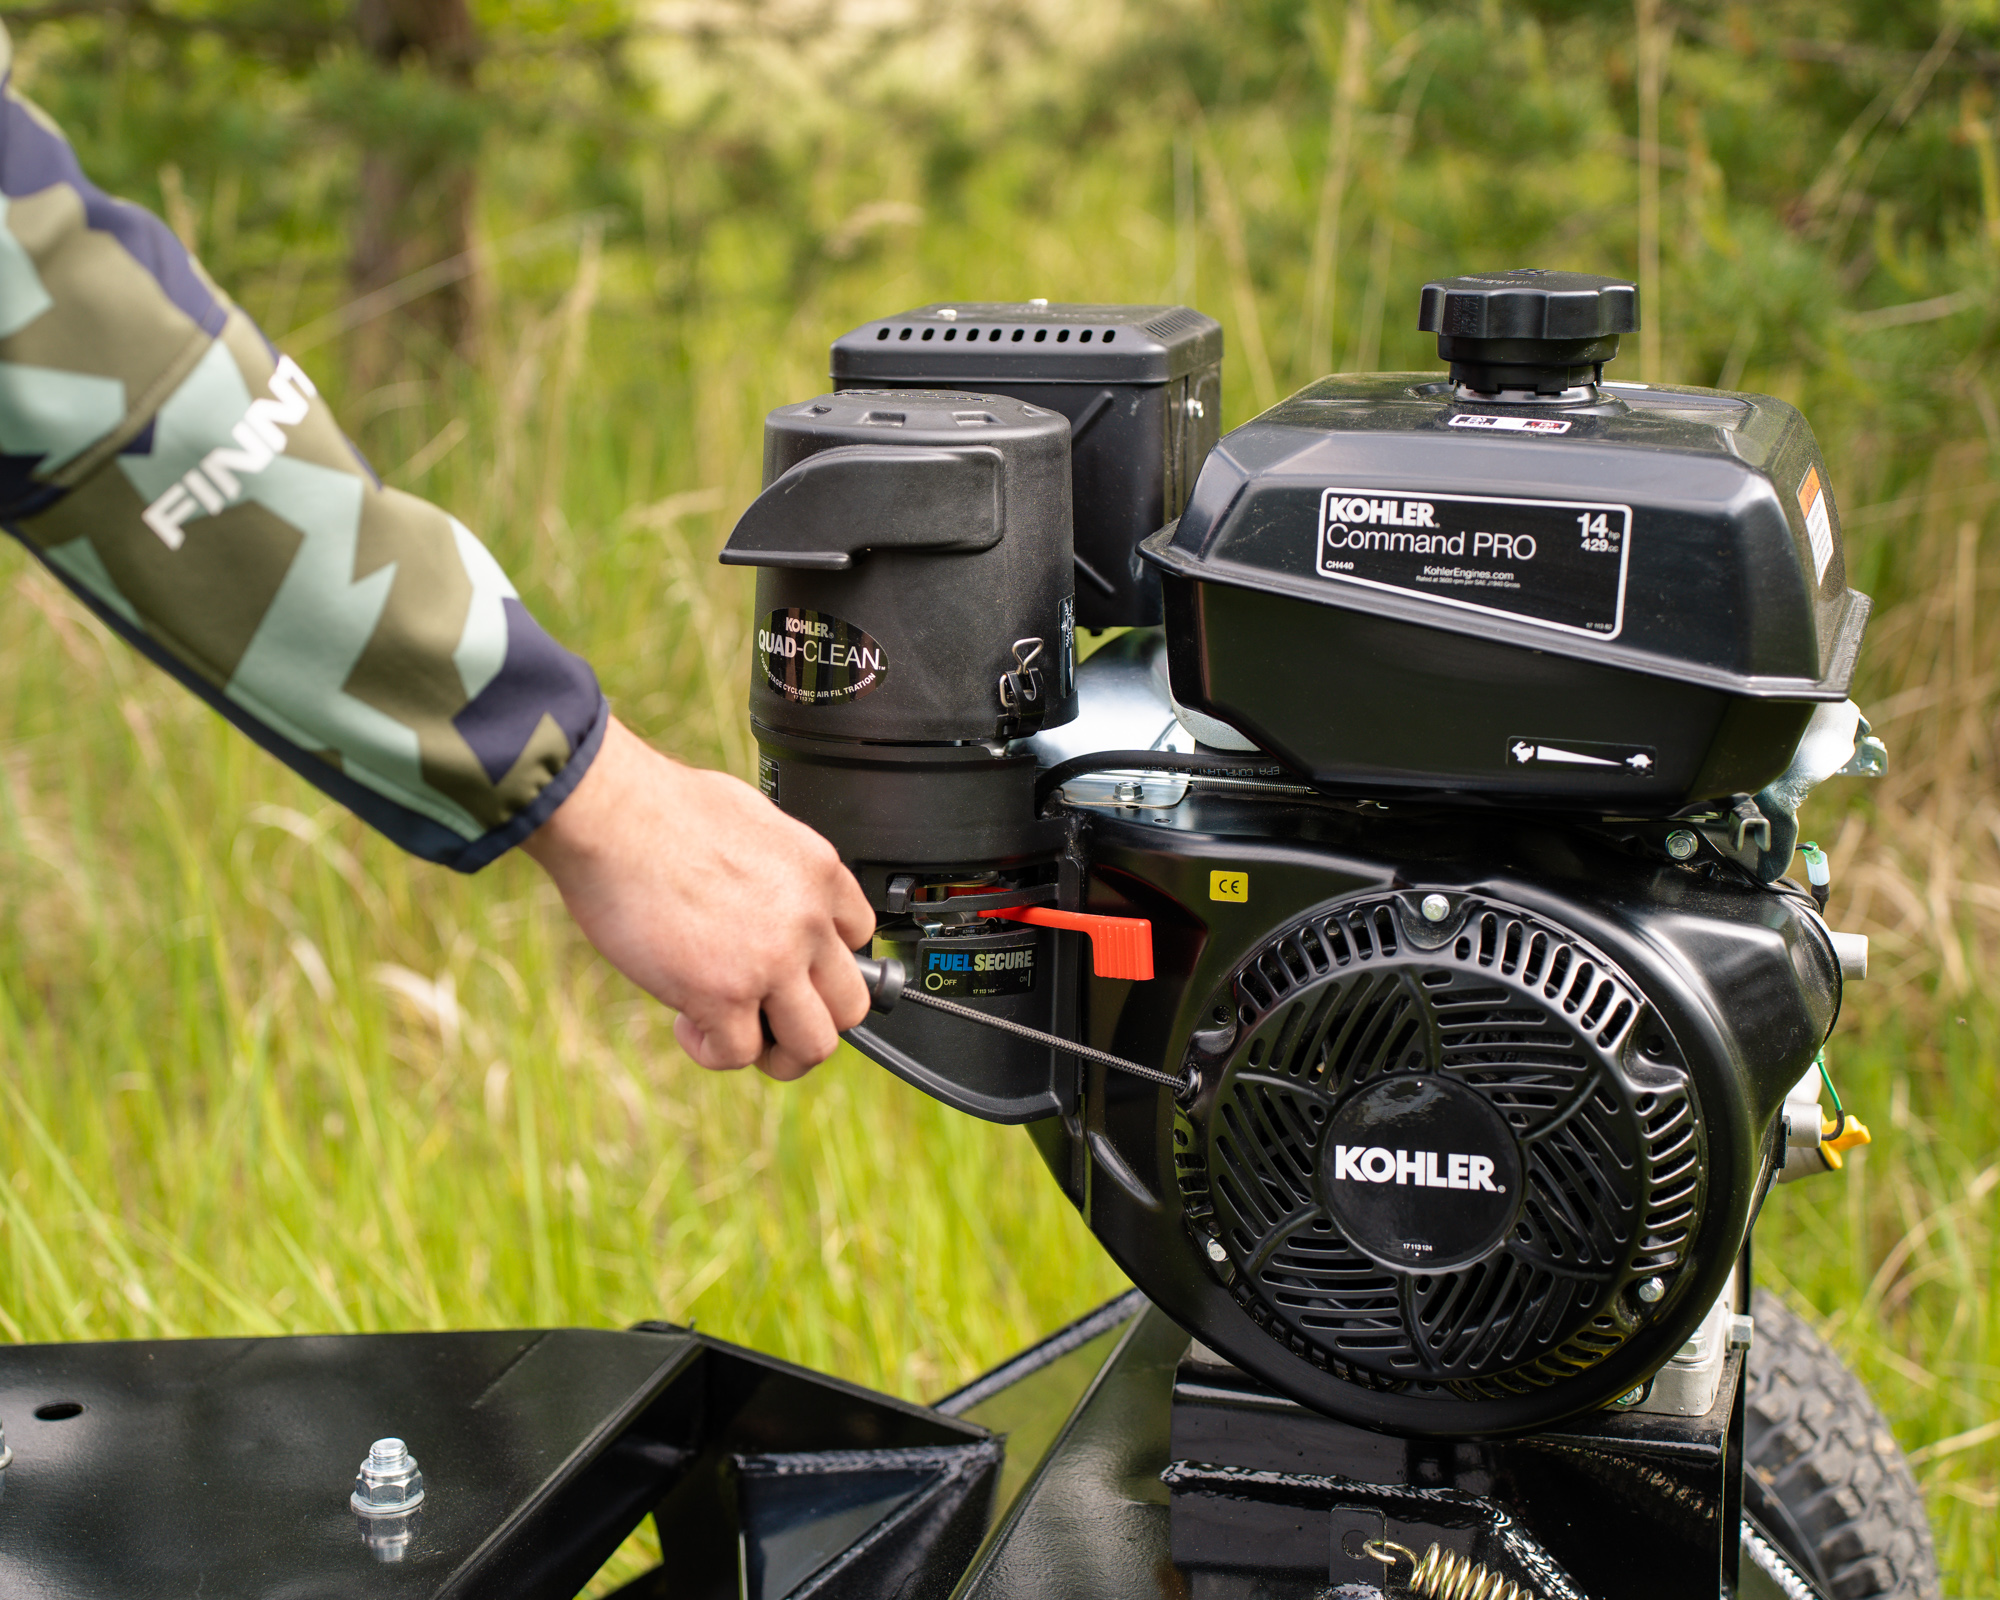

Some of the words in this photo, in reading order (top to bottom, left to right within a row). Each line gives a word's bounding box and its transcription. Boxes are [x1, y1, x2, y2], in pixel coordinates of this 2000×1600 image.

[1326, 523, 1465, 556] Command
[1473, 531, 1537, 561] PRO
[1325, 560, 1354, 570] CH440
[1423, 565, 1515, 581] KohlerEngines.com
[783, 684, 815, 698] CYCLONIC
[816, 690, 830, 698] AIR
[1259, 766, 1280, 776] EPA
[1218, 879, 1240, 894] CE
[1402, 1242, 1410, 1250] 17
[1411, 1243, 1421, 1251] 113
